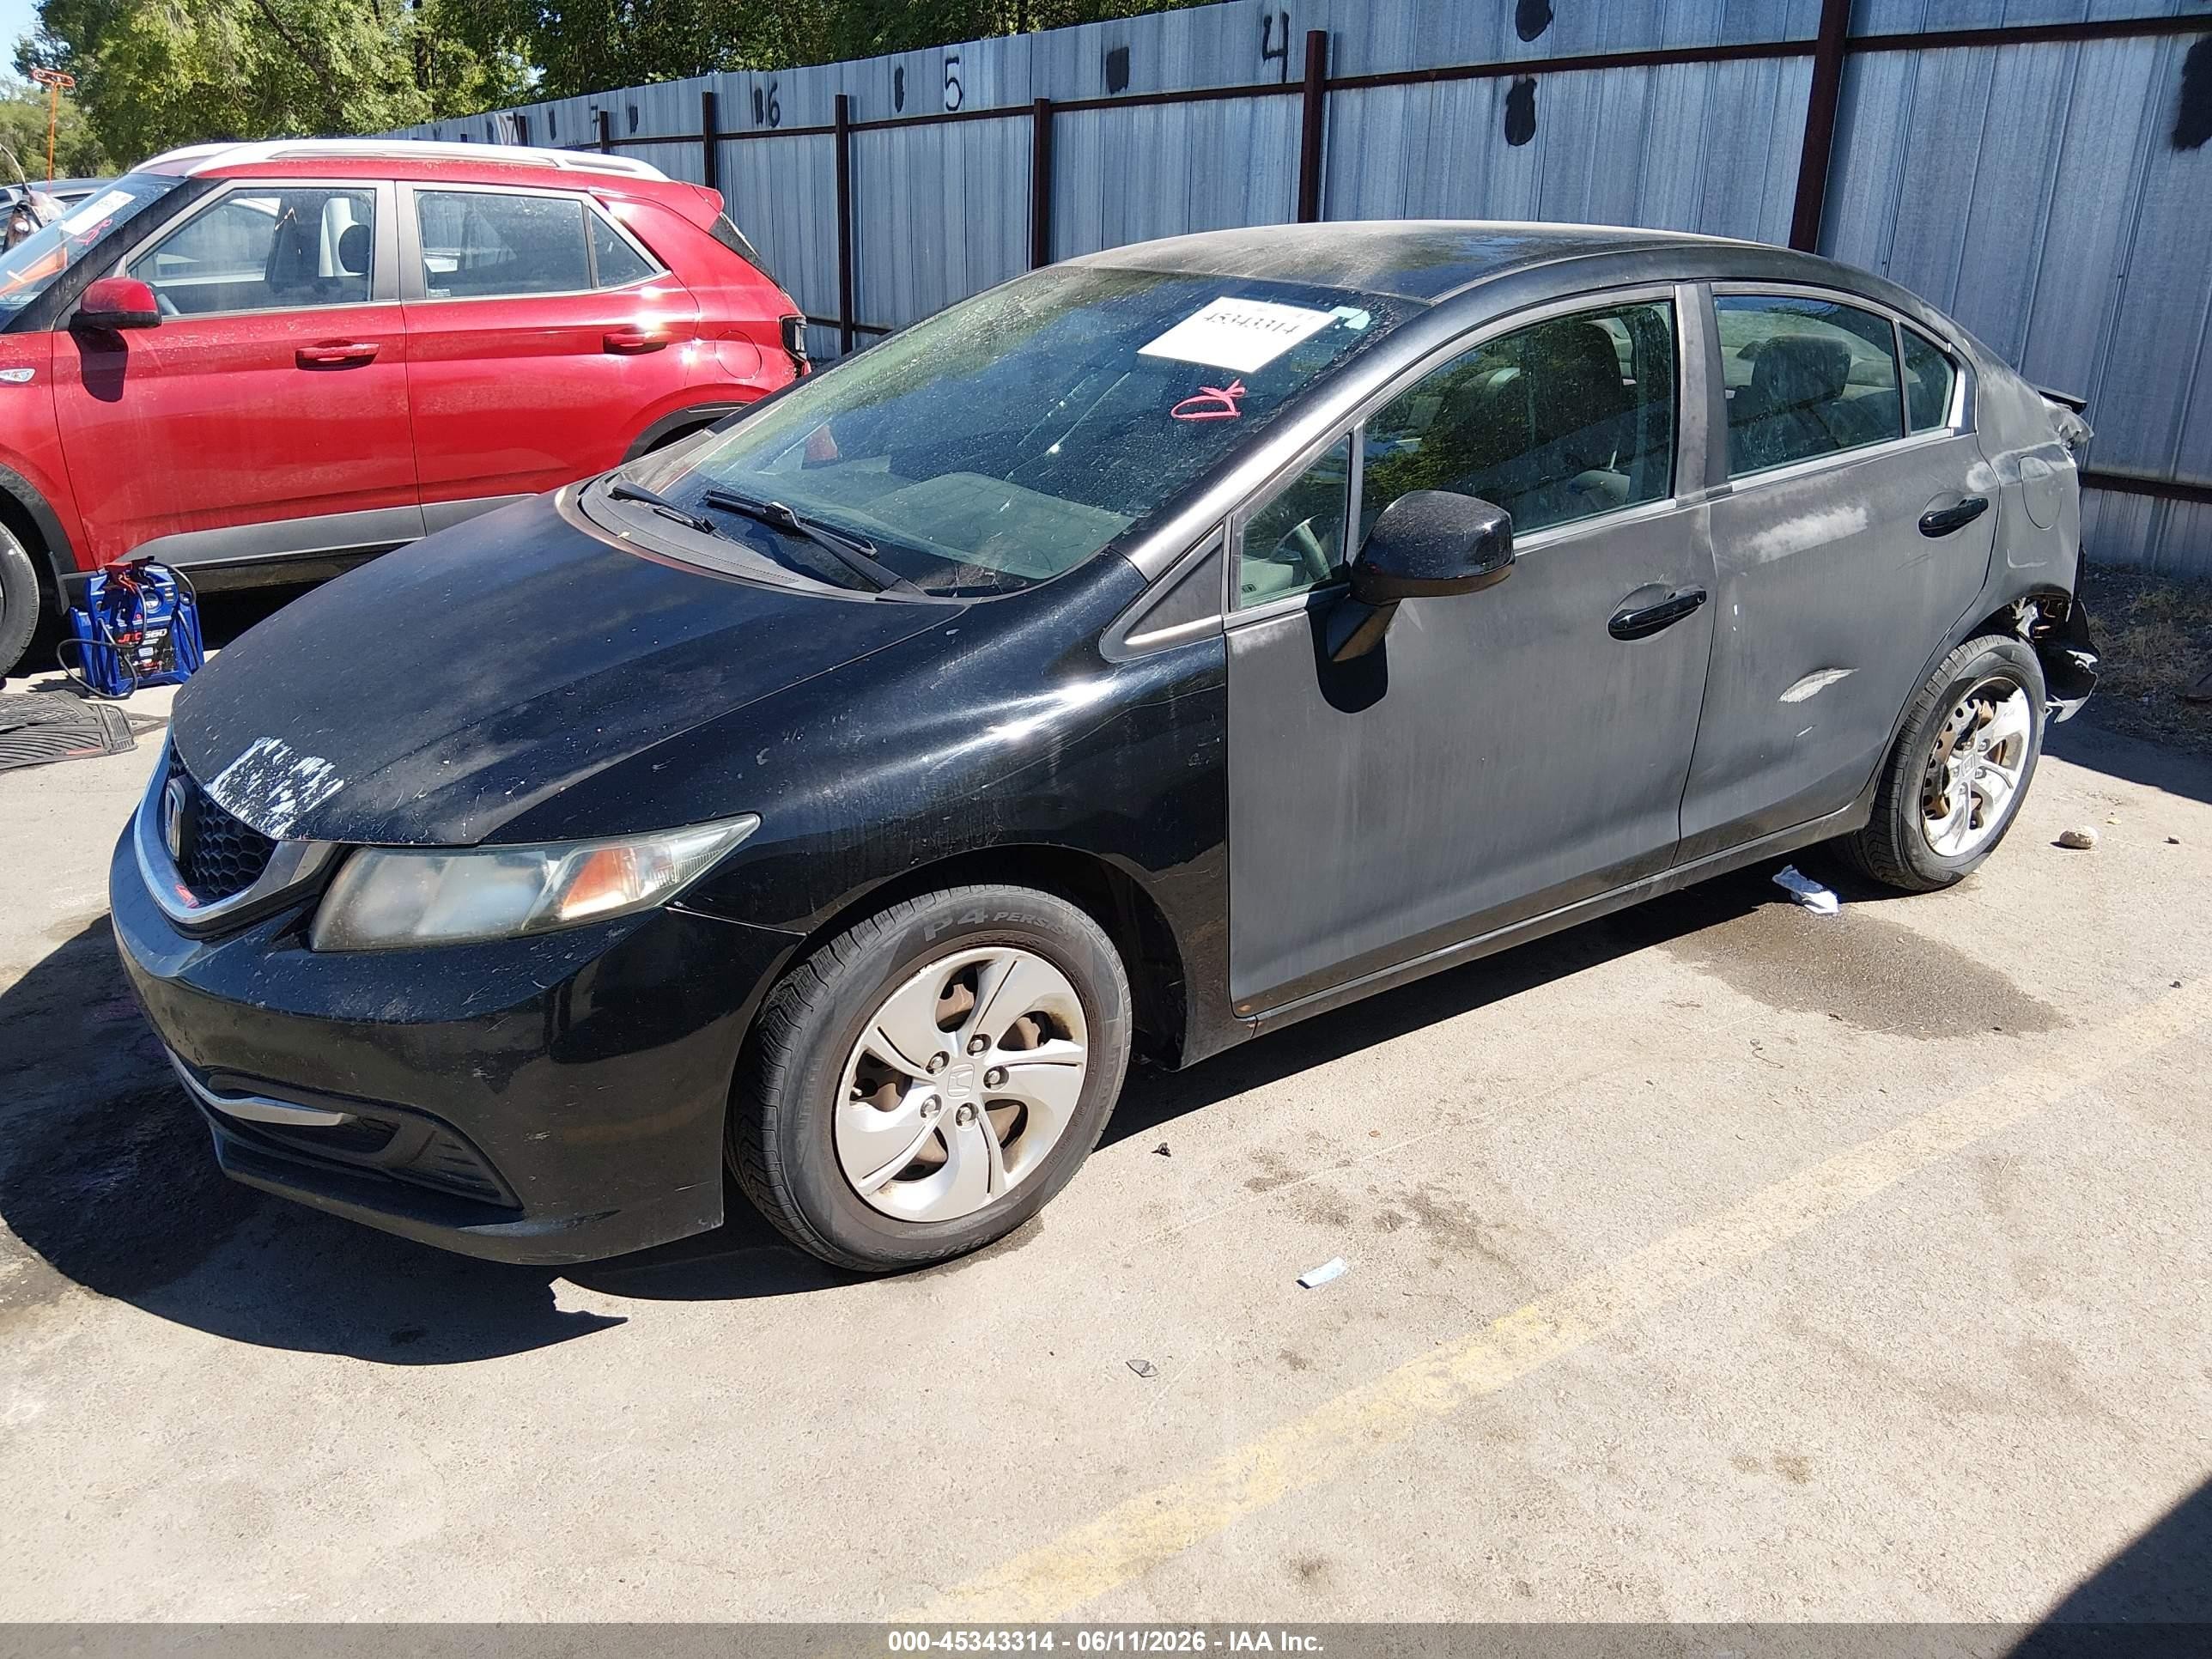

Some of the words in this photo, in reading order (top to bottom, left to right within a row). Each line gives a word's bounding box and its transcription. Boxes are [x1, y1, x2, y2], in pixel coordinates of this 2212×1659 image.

[1261, 11, 1290, 84] 4
[945, 56, 963, 112] 5
[923, 907, 989, 942] P4
